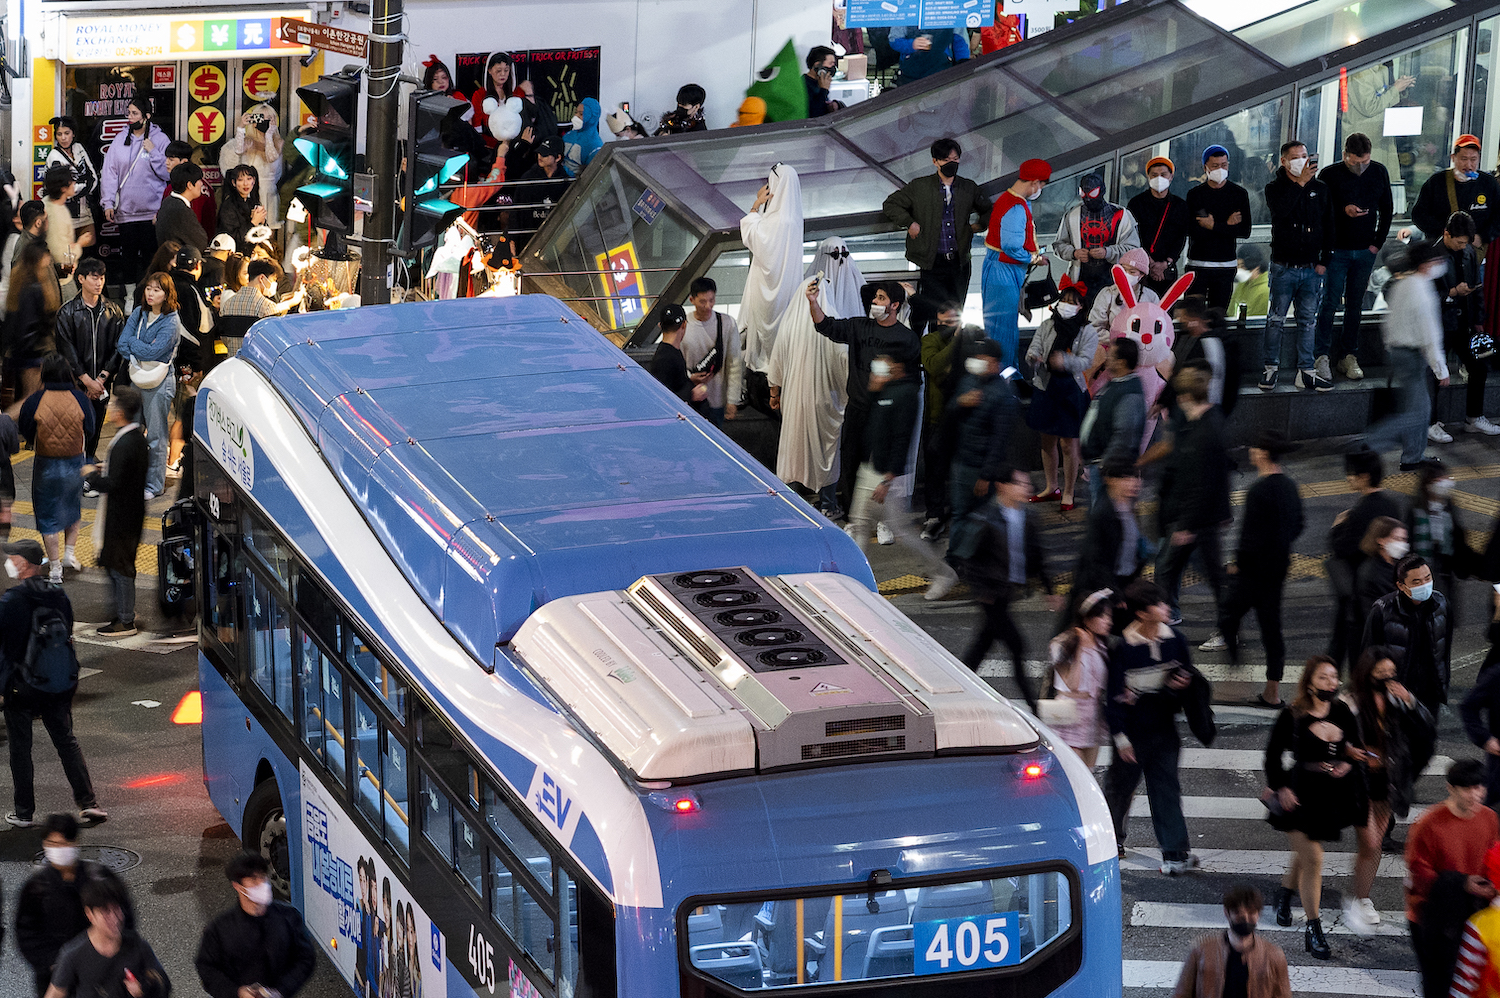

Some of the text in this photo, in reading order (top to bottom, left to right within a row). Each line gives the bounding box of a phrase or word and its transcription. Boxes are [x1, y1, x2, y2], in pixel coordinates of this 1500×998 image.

[76, 23, 163, 35] ROYAL MONEY
[76, 35, 140, 45] EXCHANGE
[115, 46, 163, 57] 02-796-2174
[531, 49, 599, 62] TRICK OR FRITES?
[458, 55, 481, 66] TRICK
[925, 917, 1010, 969] 405
[467, 923, 496, 995] 405
